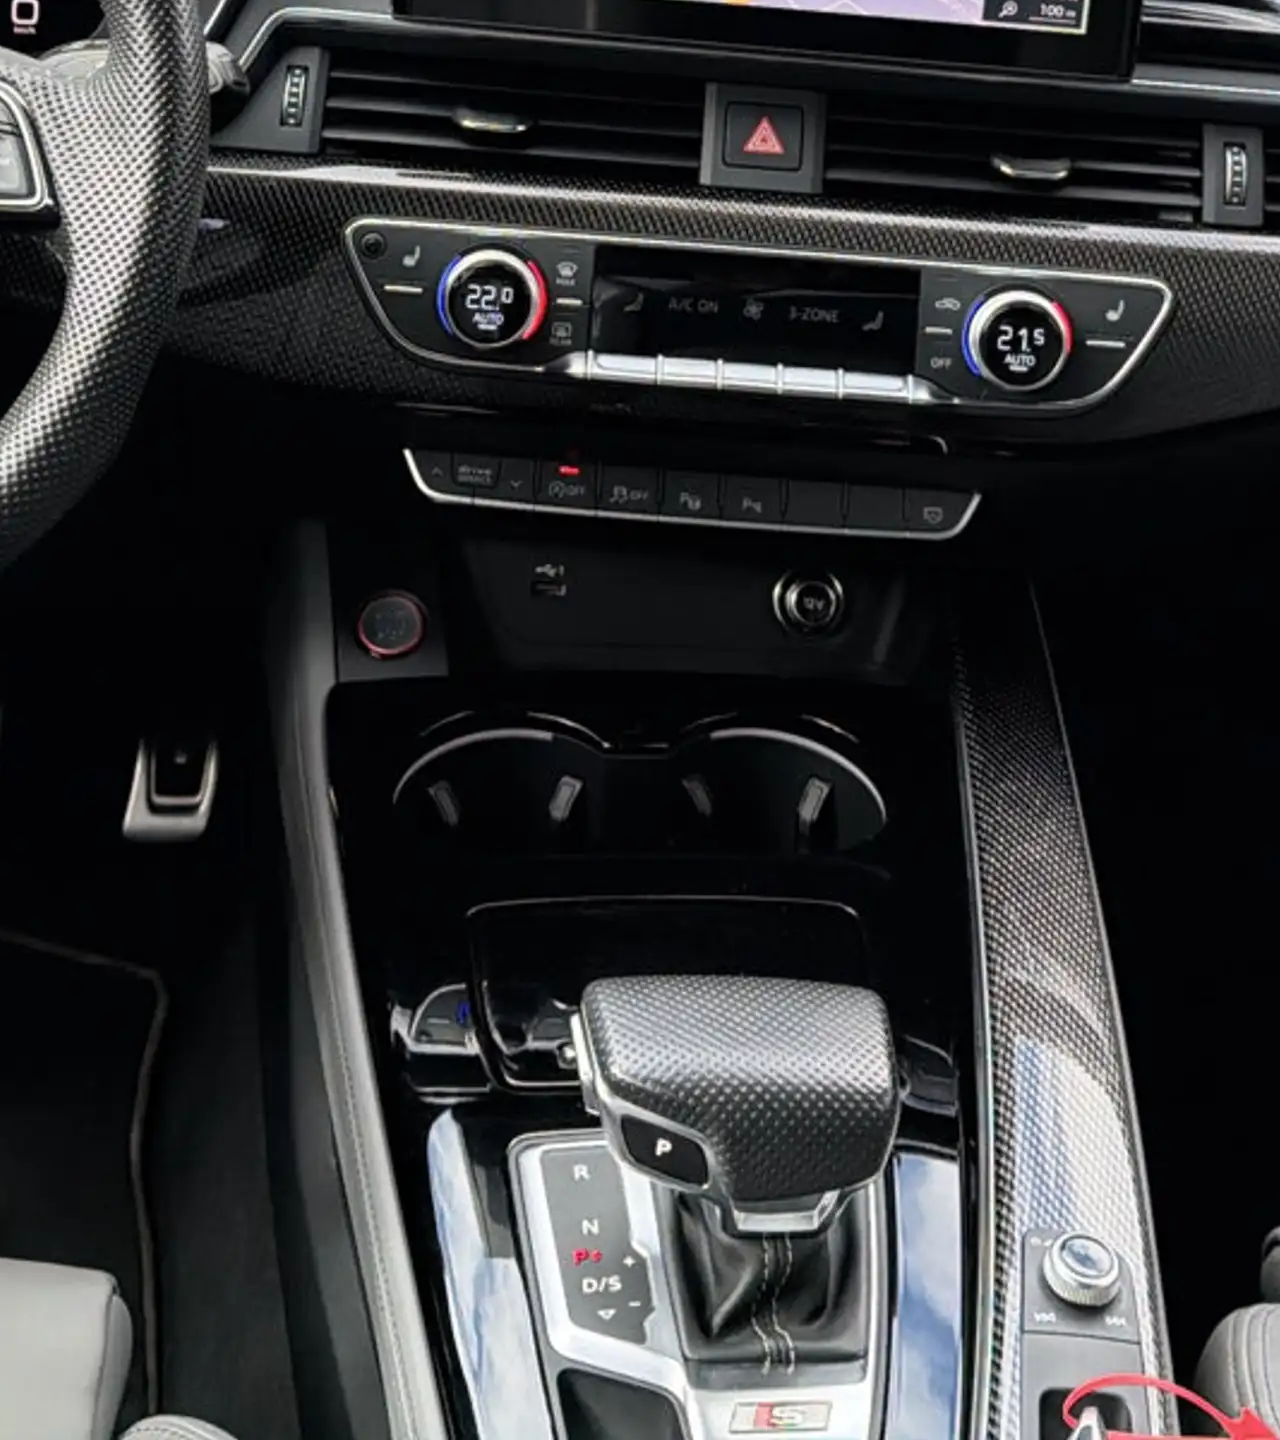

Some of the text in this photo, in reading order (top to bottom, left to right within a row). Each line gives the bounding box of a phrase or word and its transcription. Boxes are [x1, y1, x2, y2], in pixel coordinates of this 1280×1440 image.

[1039, 3, 1064, 18] 100
[697, 298, 719, 315] ON
[472, 311, 504, 326] AUTO
[1004, 352, 1037, 367] AUTO
[654, 1137, 673, 1157] P
[573, 1163, 590, 1182] R
[581, 1218, 600, 1236] N
[581, 1276, 623, 1294] D/S
